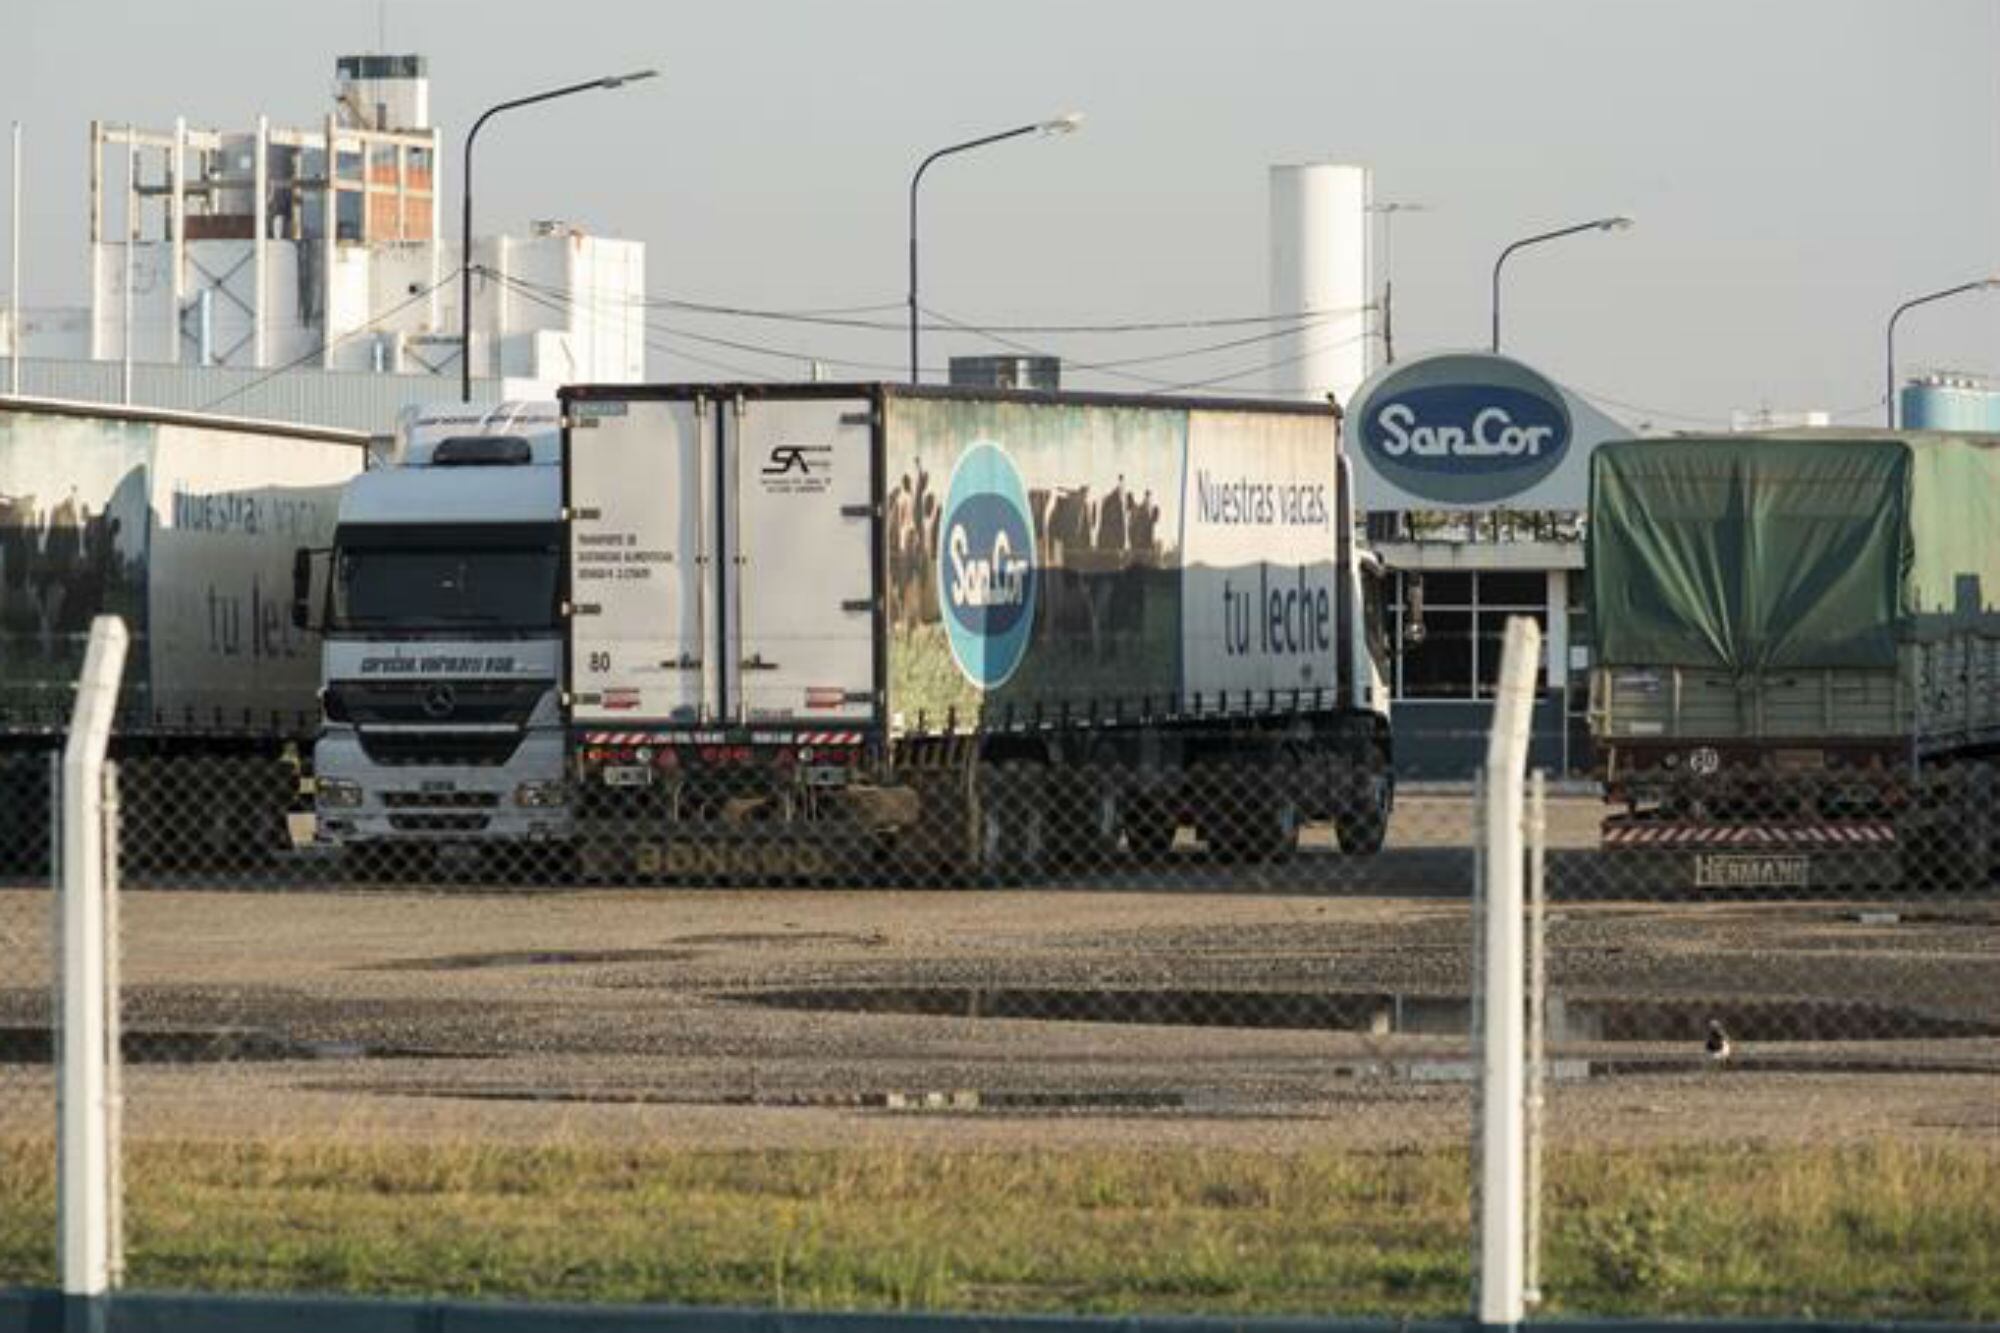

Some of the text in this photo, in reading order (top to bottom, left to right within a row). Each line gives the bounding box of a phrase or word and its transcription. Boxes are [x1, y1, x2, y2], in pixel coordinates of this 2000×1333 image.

[1378, 403, 1552, 455] SanCor
[173, 478, 264, 535] Nuestra
[1197, 469, 1273, 525] Nuestras
[950, 524, 1028, 607] SanCor
[208, 572, 296, 659] tu lec
[1224, 561, 1330, 655] tu leche
[589, 651, 611, 673] 80
